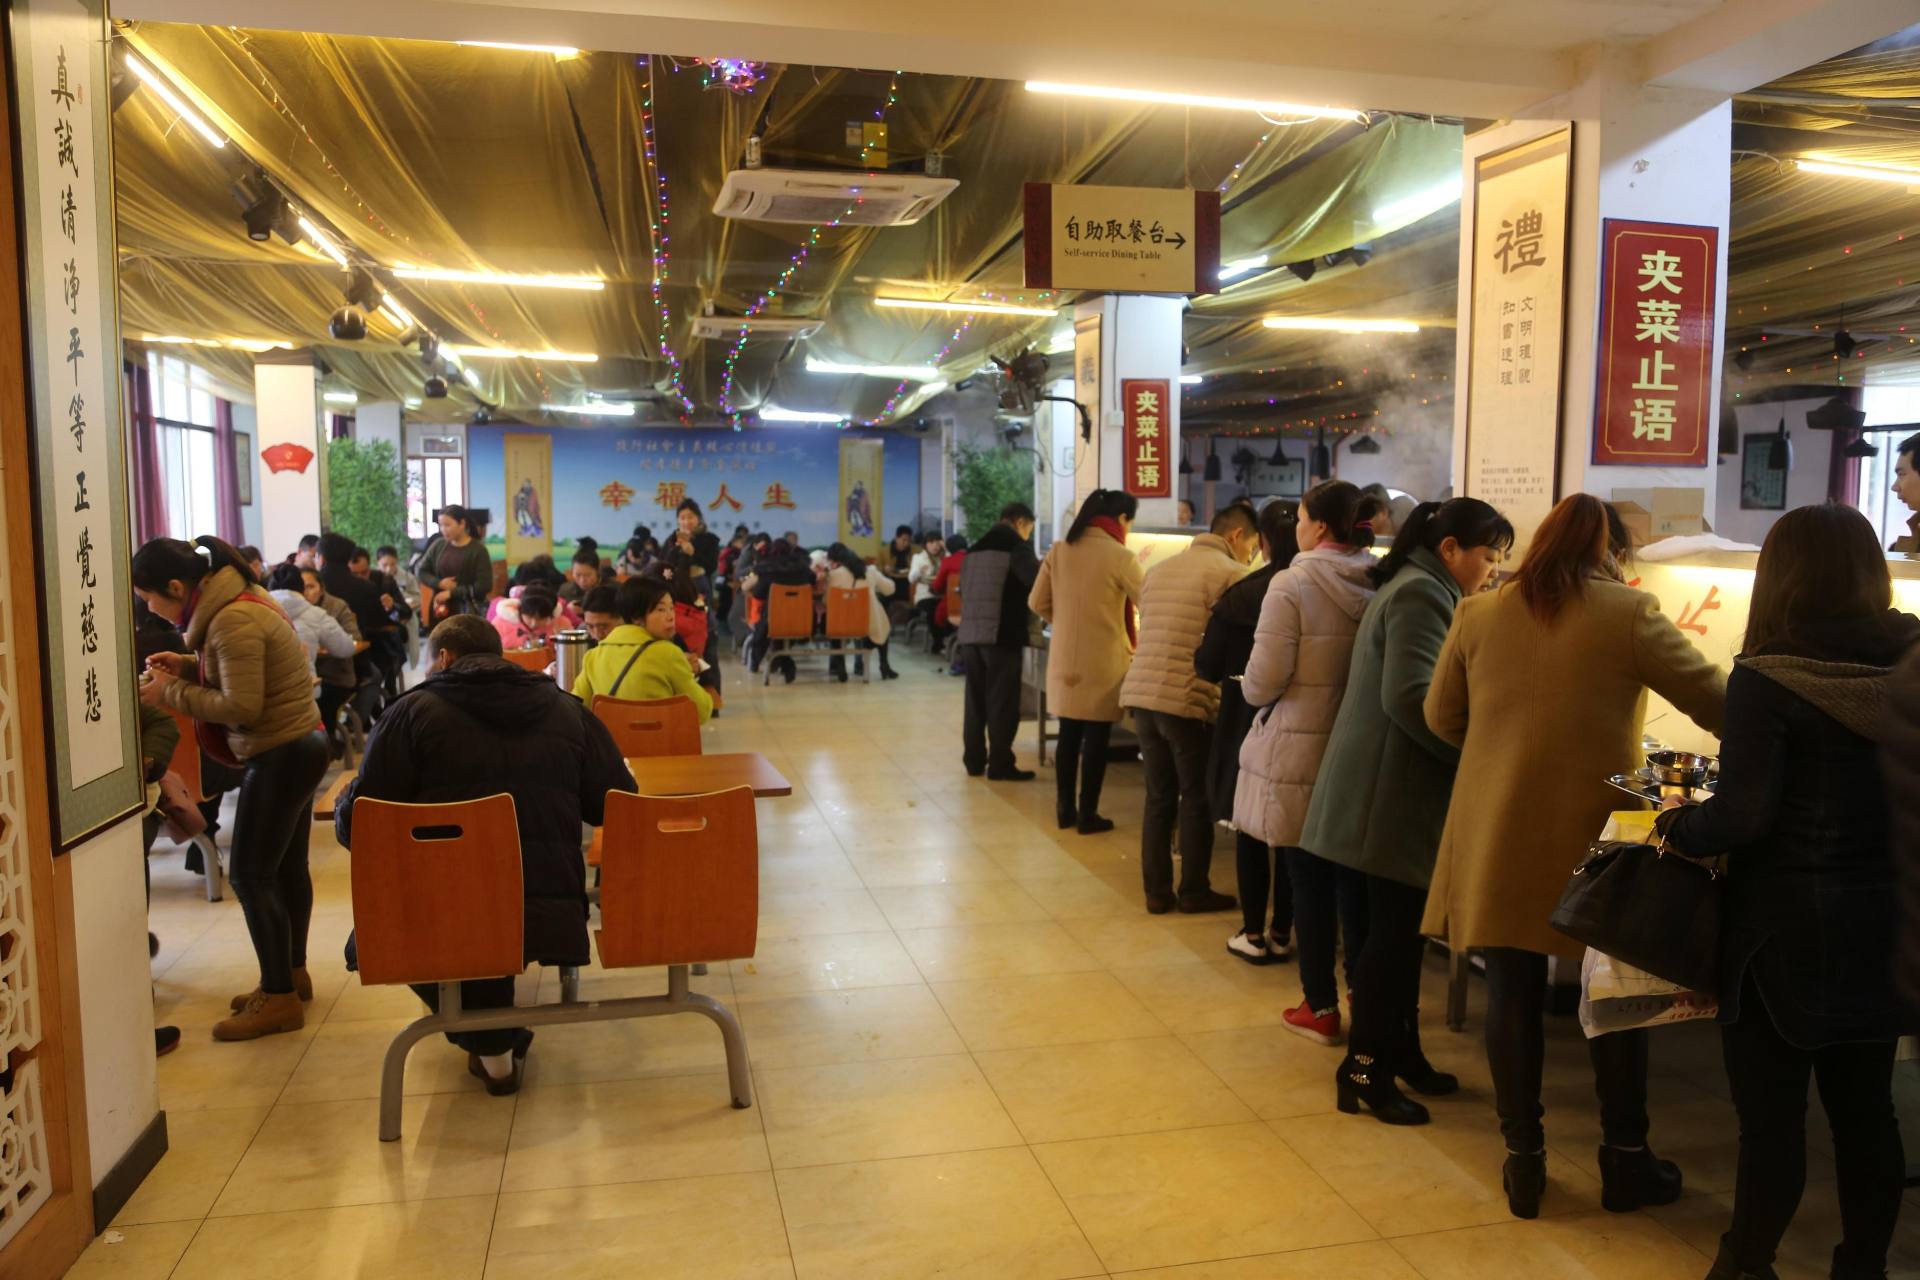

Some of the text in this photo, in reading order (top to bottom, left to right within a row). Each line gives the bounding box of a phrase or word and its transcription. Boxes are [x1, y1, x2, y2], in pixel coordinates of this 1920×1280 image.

[1065, 215, 1165, 244] 自助取餐台
[1493, 209, 1546, 275] 禮
[1064, 248, 1162, 261] Self-service Dining Table
[1630, 250, 1683, 442] 夹菜止语
[1136, 390, 1160, 487] 夹菜止语
[599, 480, 797, 512] 幸福人生
